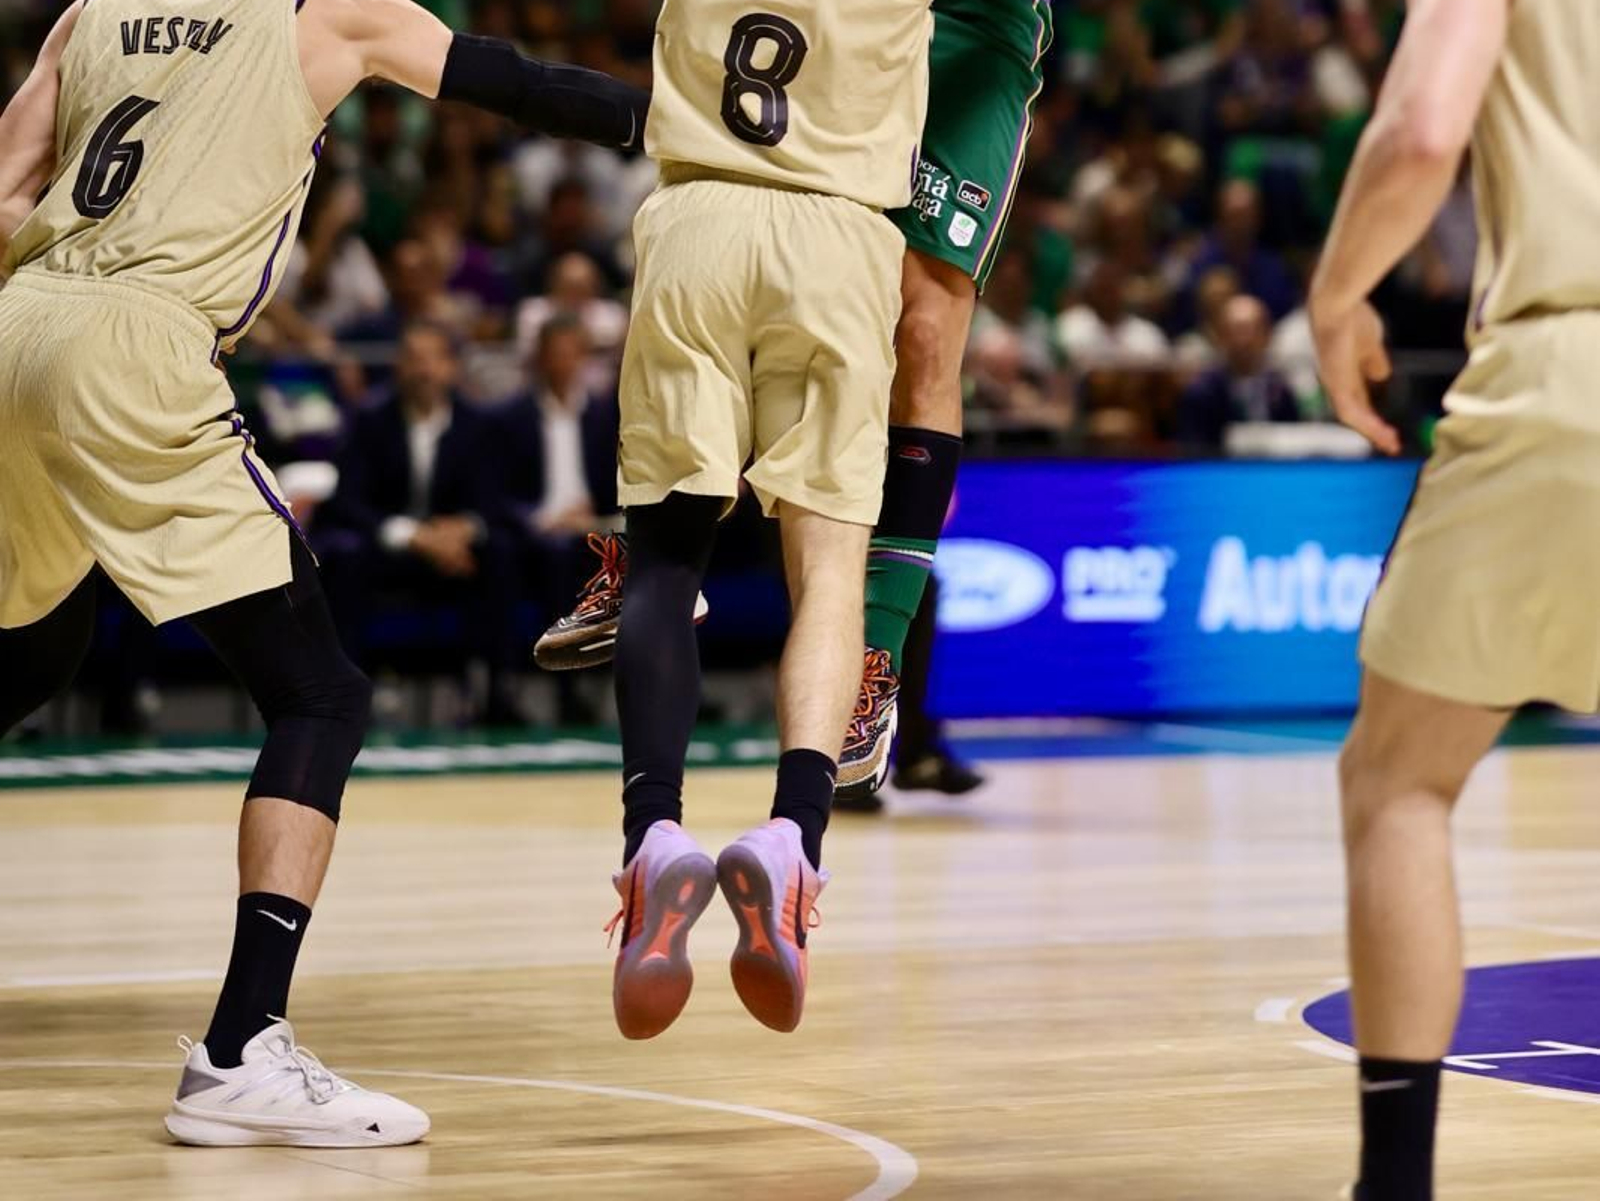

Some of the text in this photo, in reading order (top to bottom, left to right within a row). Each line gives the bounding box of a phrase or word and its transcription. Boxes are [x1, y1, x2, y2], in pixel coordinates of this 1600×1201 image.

[720, 12, 809, 148] 8
[71, 95, 161, 220] 6
[960, 189, 983, 206] acb
